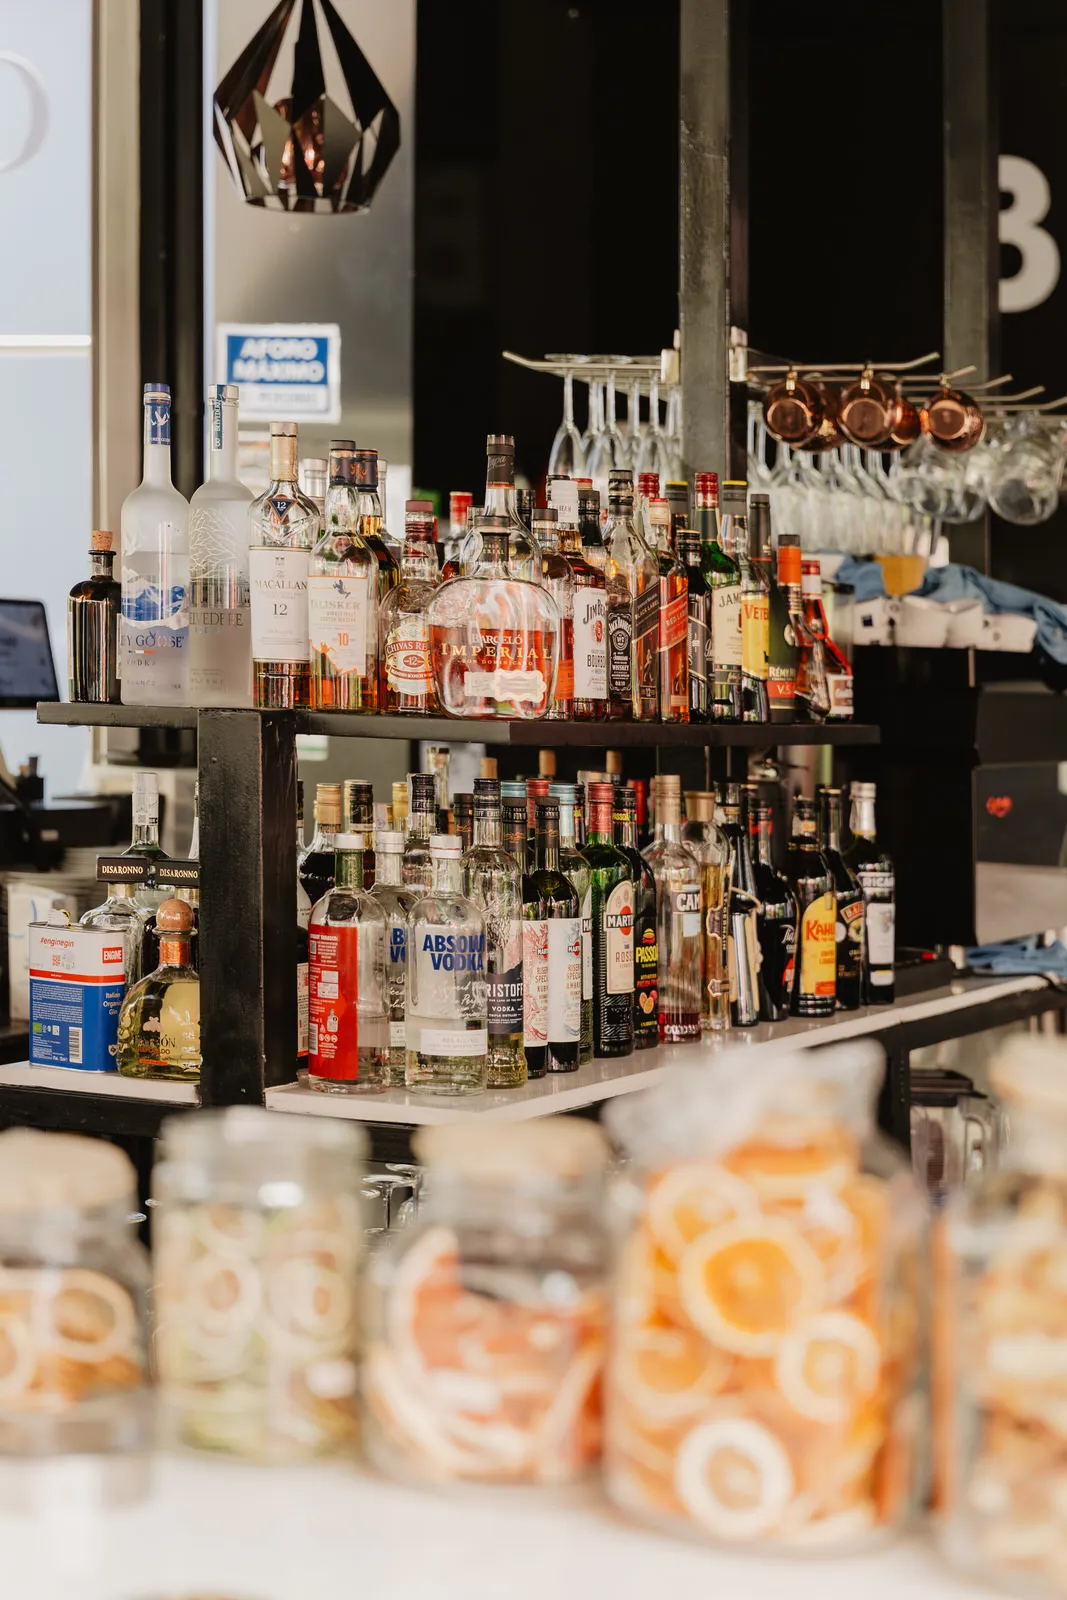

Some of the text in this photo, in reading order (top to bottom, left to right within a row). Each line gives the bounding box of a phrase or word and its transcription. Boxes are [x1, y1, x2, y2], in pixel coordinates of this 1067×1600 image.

[241, 338, 318, 360] AFORO
[276, 501, 287, 509] 12
[255, 580, 308, 590] MACALLAN
[273, 604, 288, 616] 12
[310, 599, 360, 610] TALISKER
[666, 616, 677, 626] RED
[136, 633, 183, 648] GOOSE
[337, 633, 349, 646] 10
[472, 633, 523, 645] BARCELÓ
[386, 641, 413, 654] CHIVAS
[441, 642, 552, 660] IMPERIAL
[408, 656, 417, 666] 12
[769, 666, 789, 677] RÉMY
[102, 866, 144, 875] DISARONNO
[159, 868, 198, 879] DISARONNO
[40, 936, 75, 948] #enginegin
[103, 950, 122, 961] ENGINE
[431, 953, 484, 971] VODKA
[103, 1000, 123, 1008] Organic
